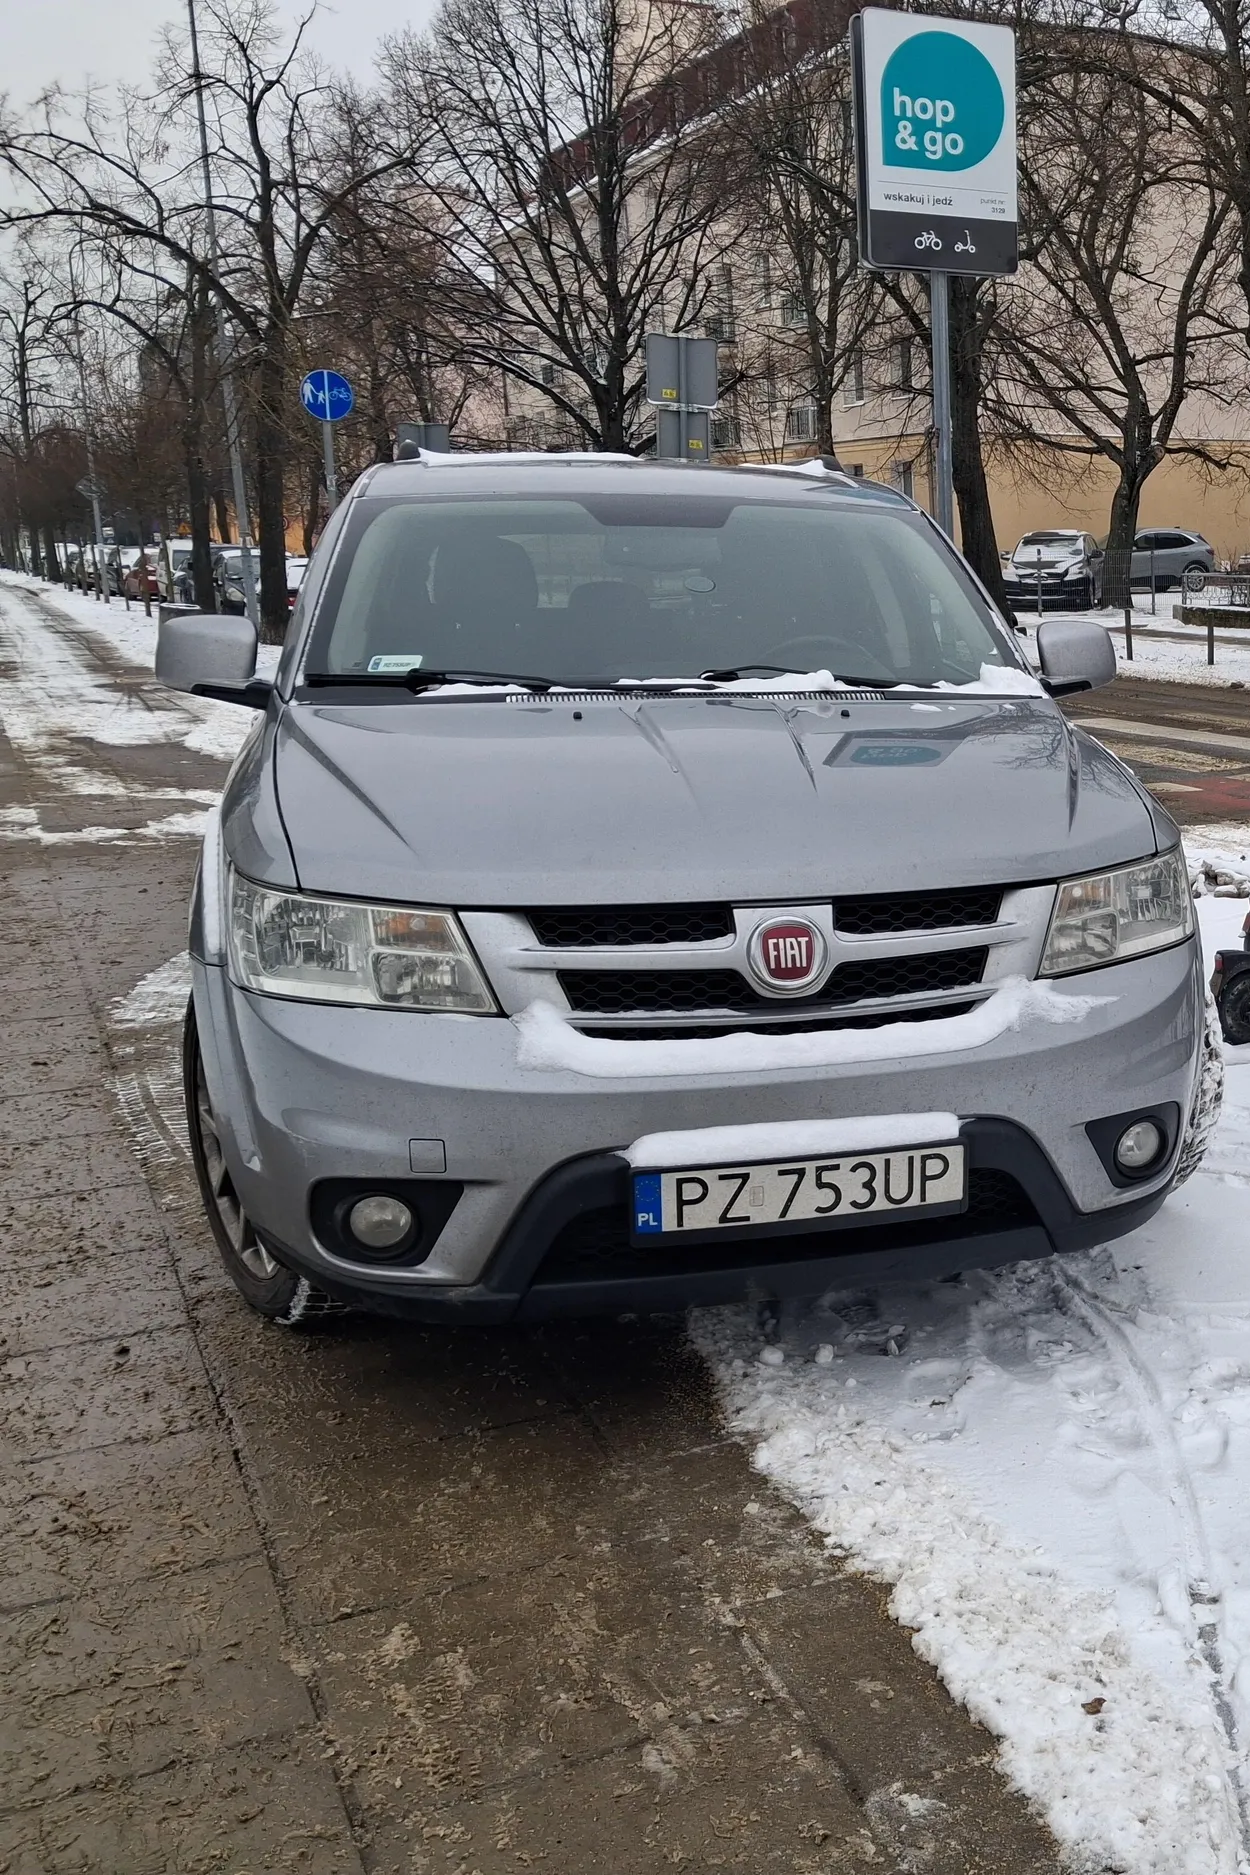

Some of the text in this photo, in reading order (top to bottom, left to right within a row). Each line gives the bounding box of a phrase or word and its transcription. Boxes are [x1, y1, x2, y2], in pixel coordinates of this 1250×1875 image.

[893, 87, 955, 128] hop
[894, 120, 965, 160] & go
[883, 192, 954, 206] wskakuj i jedź
[767, 936, 809, 969] FIAT
[675, 1152, 950, 1228] PZ 753UP
[637, 1213, 658, 1226] PL
